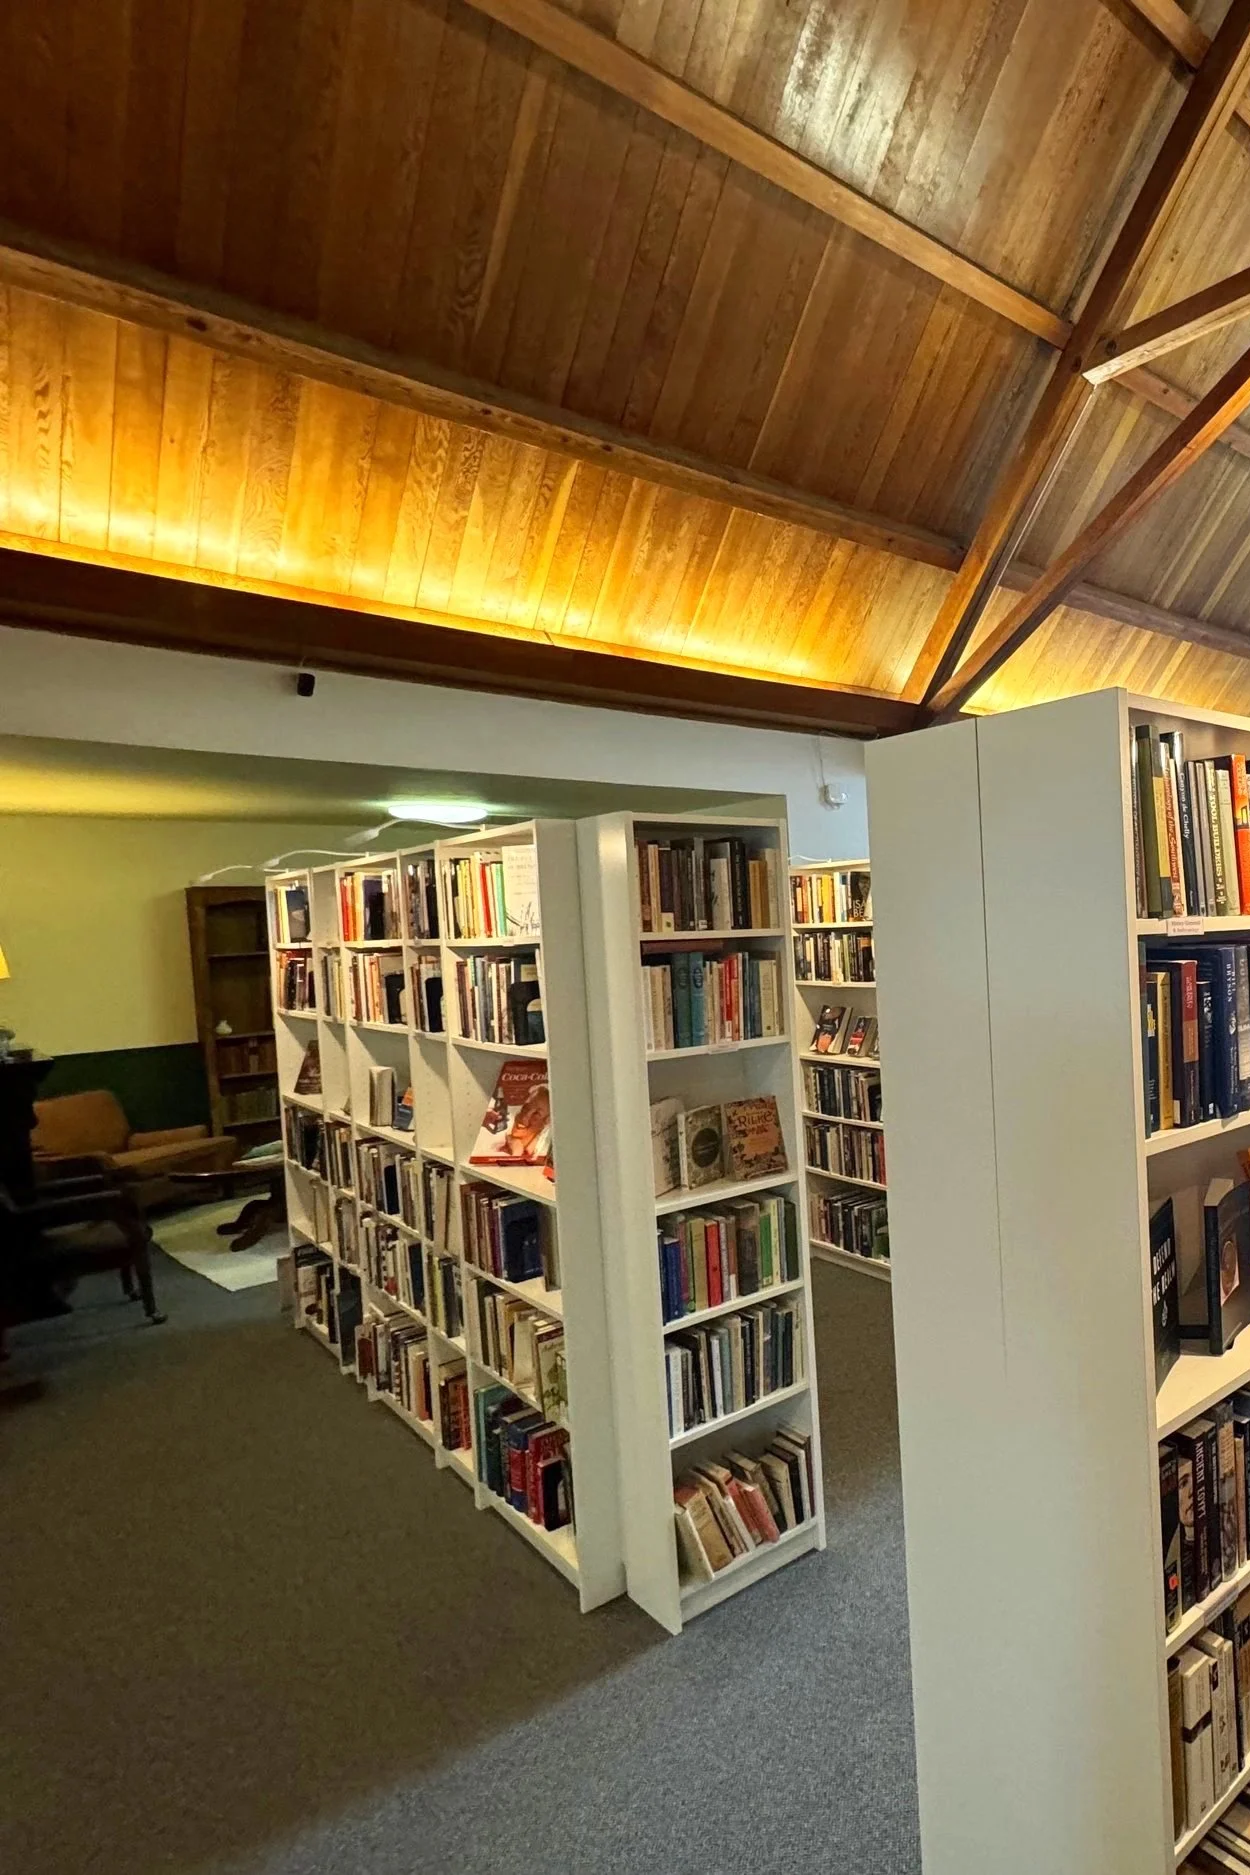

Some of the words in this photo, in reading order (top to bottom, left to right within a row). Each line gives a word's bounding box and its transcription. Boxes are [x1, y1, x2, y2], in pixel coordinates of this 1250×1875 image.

[1178, 772, 1187, 802] Canyon
[1182, 803, 1188, 813] de
[1209, 795, 1218, 823] TOOL
[1182, 814, 1191, 839] Chelly
[1195, 1441, 1205, 1484] ANCIENT
[1197, 1488, 1207, 1519] EGYPT
